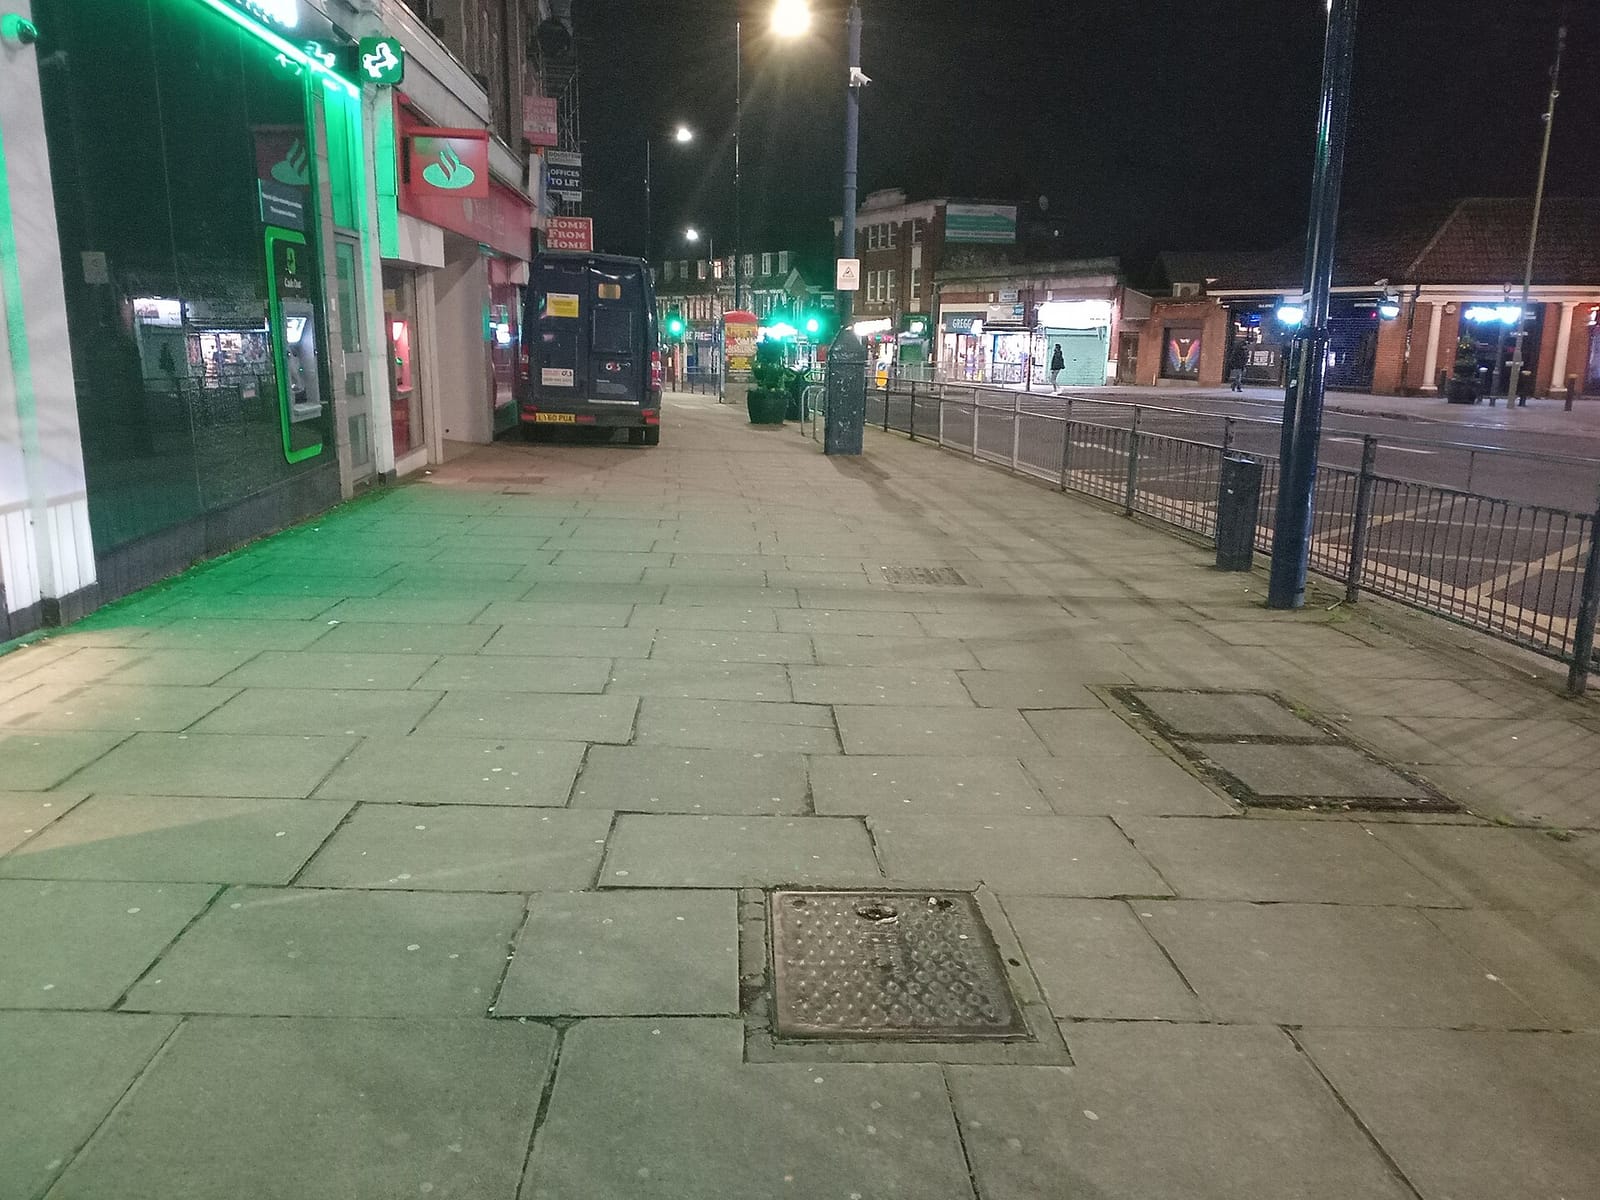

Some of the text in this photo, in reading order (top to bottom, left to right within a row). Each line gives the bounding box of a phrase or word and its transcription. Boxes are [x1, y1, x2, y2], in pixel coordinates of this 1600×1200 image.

[551, 169, 580, 177] OFFICES
[564, 179, 579, 187] LET
[546, 218, 587, 229] HOME
[549, 229, 585, 239] FROM
[547, 239, 587, 249] HOME
[952, 318, 972, 328] GREGG
